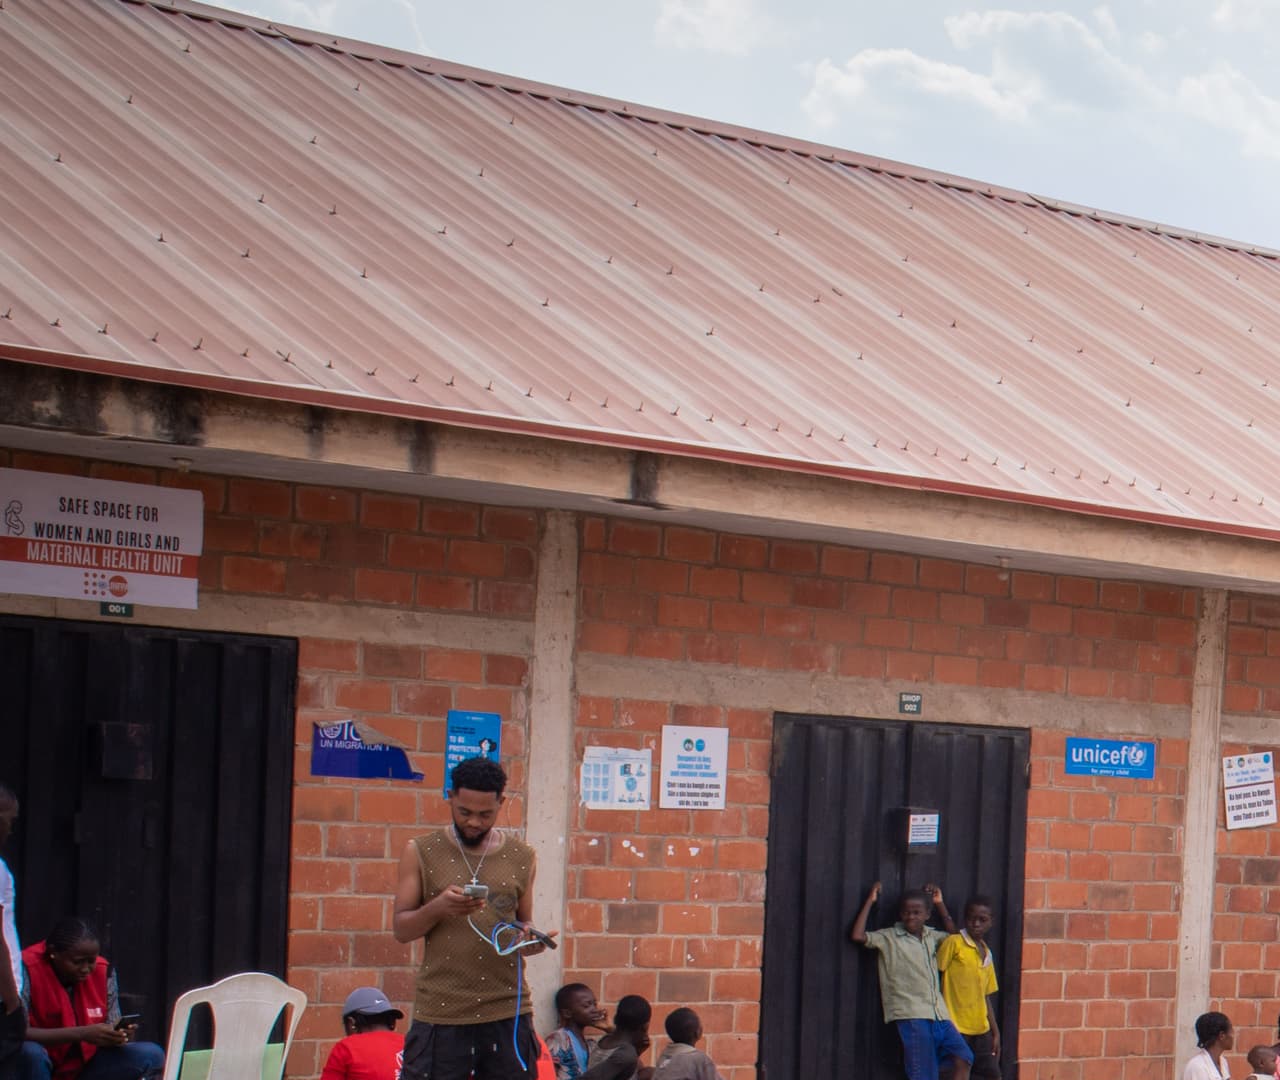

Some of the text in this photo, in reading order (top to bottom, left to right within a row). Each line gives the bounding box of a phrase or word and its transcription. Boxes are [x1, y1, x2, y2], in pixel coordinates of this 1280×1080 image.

[59, 497, 159, 522] SAFE SPACE FOR
[34, 522, 180, 551] WOMEN AND GIRLS AND
[27, 541, 183, 575] MATERNAL HEALTH UNIT
[109, 604, 126, 614] 001
[320, 739, 333, 748] UN
[1071, 743, 1128, 765] unicef
